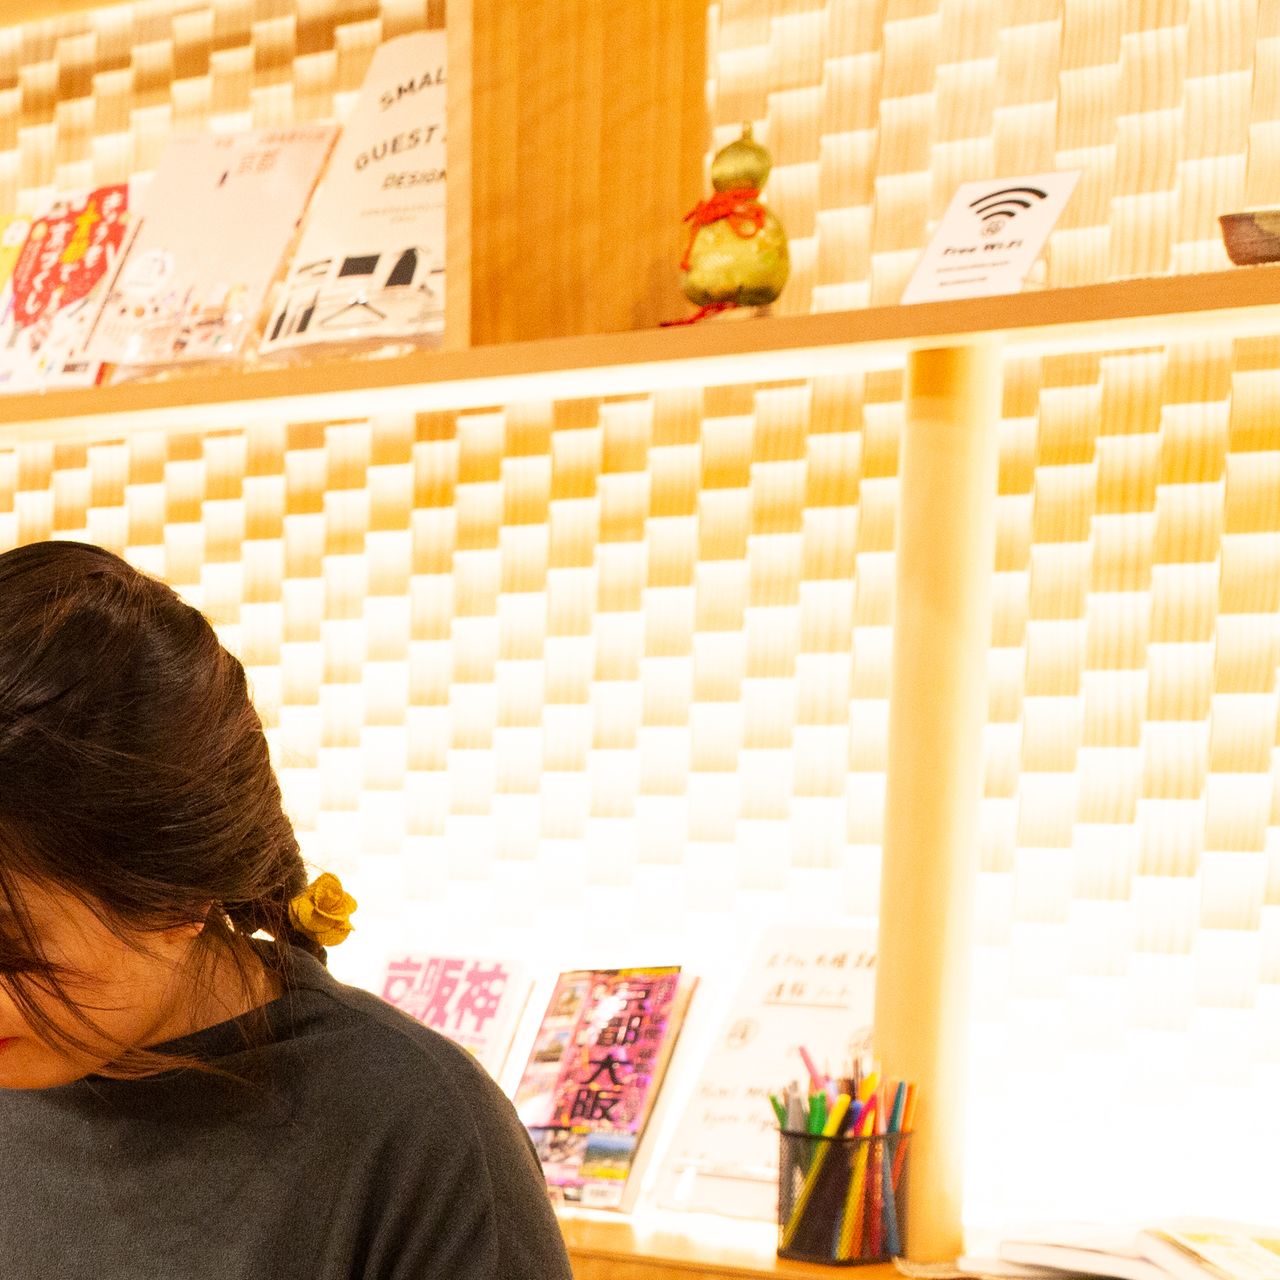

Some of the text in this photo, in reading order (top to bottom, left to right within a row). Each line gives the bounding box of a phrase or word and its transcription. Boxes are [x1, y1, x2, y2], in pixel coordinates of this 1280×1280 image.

[354, 124, 439, 172] GUEST
[944, 246, 978, 255] Free
[383, 957, 508, 1032] 京阪神
